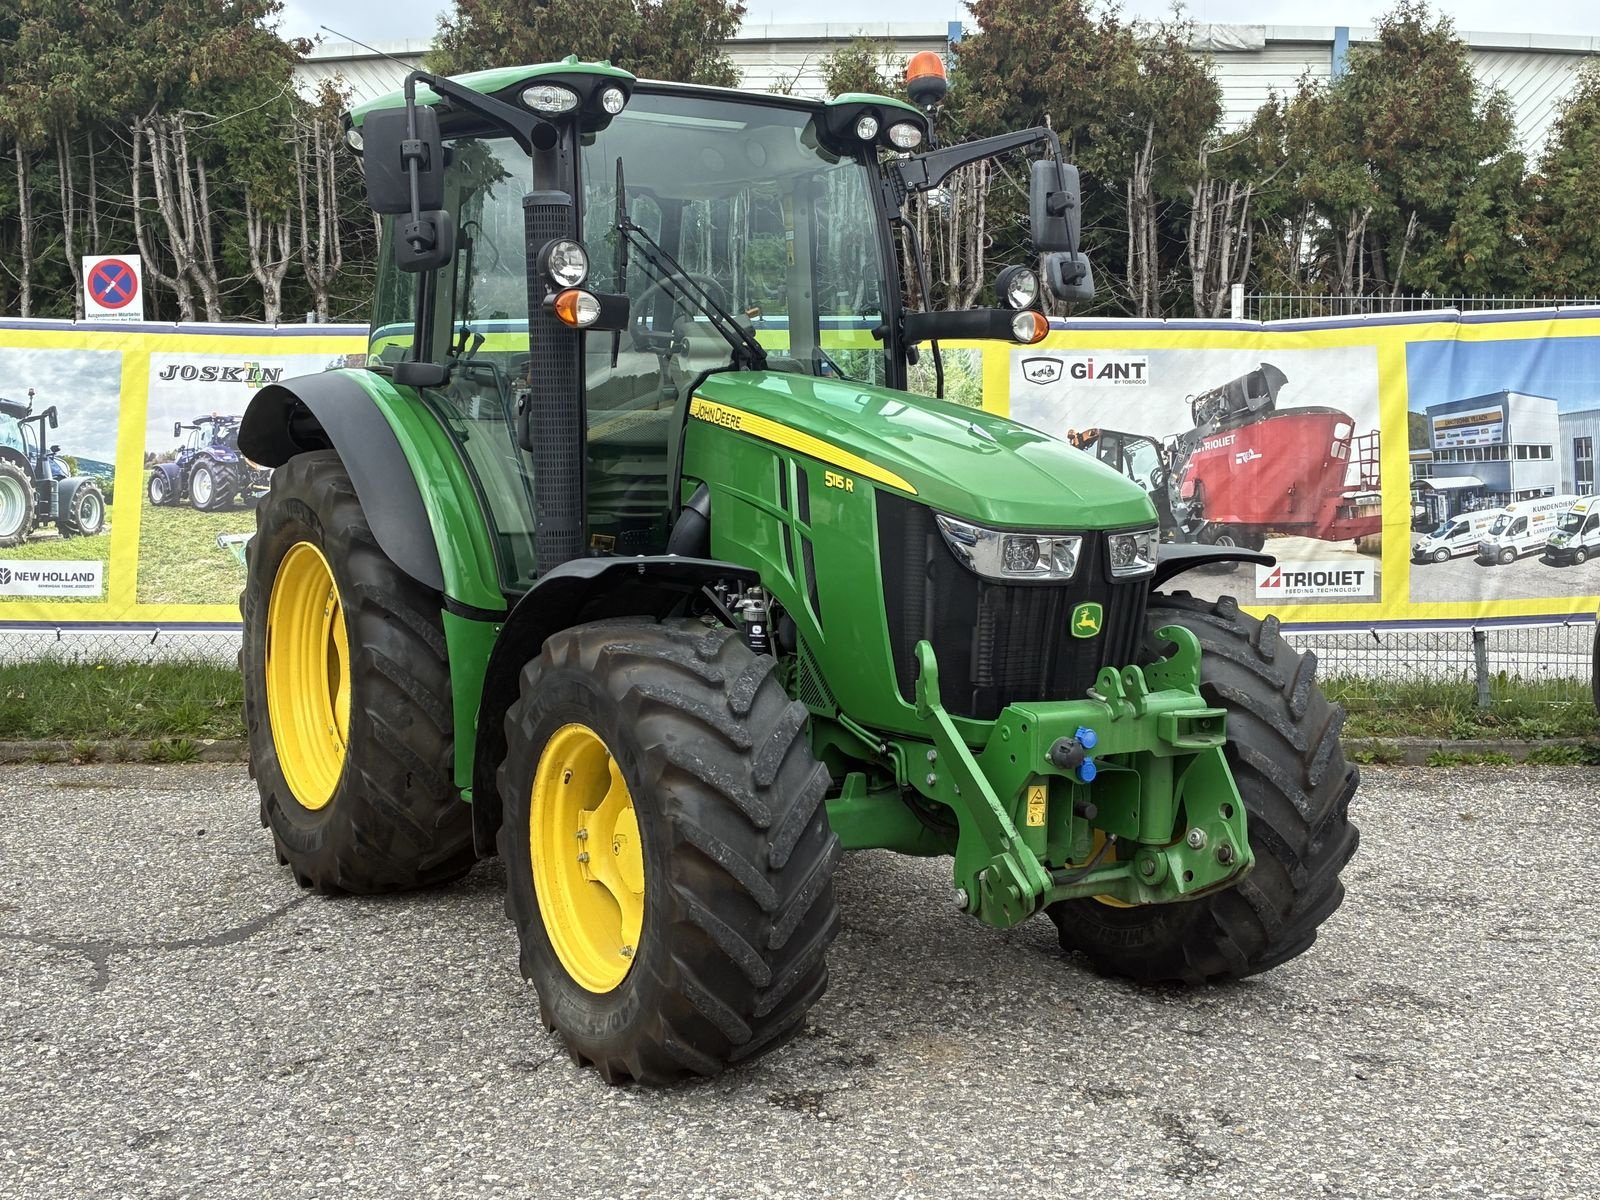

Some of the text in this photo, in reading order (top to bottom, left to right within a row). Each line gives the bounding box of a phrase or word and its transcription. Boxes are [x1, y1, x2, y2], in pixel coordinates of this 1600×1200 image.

[159, 364, 283, 384] JOSKIN
[714, 407, 742, 429] DEERE
[14, 571, 95, 582] NEW HOLLAND
[1282, 570, 1365, 588] TRIOLIET
